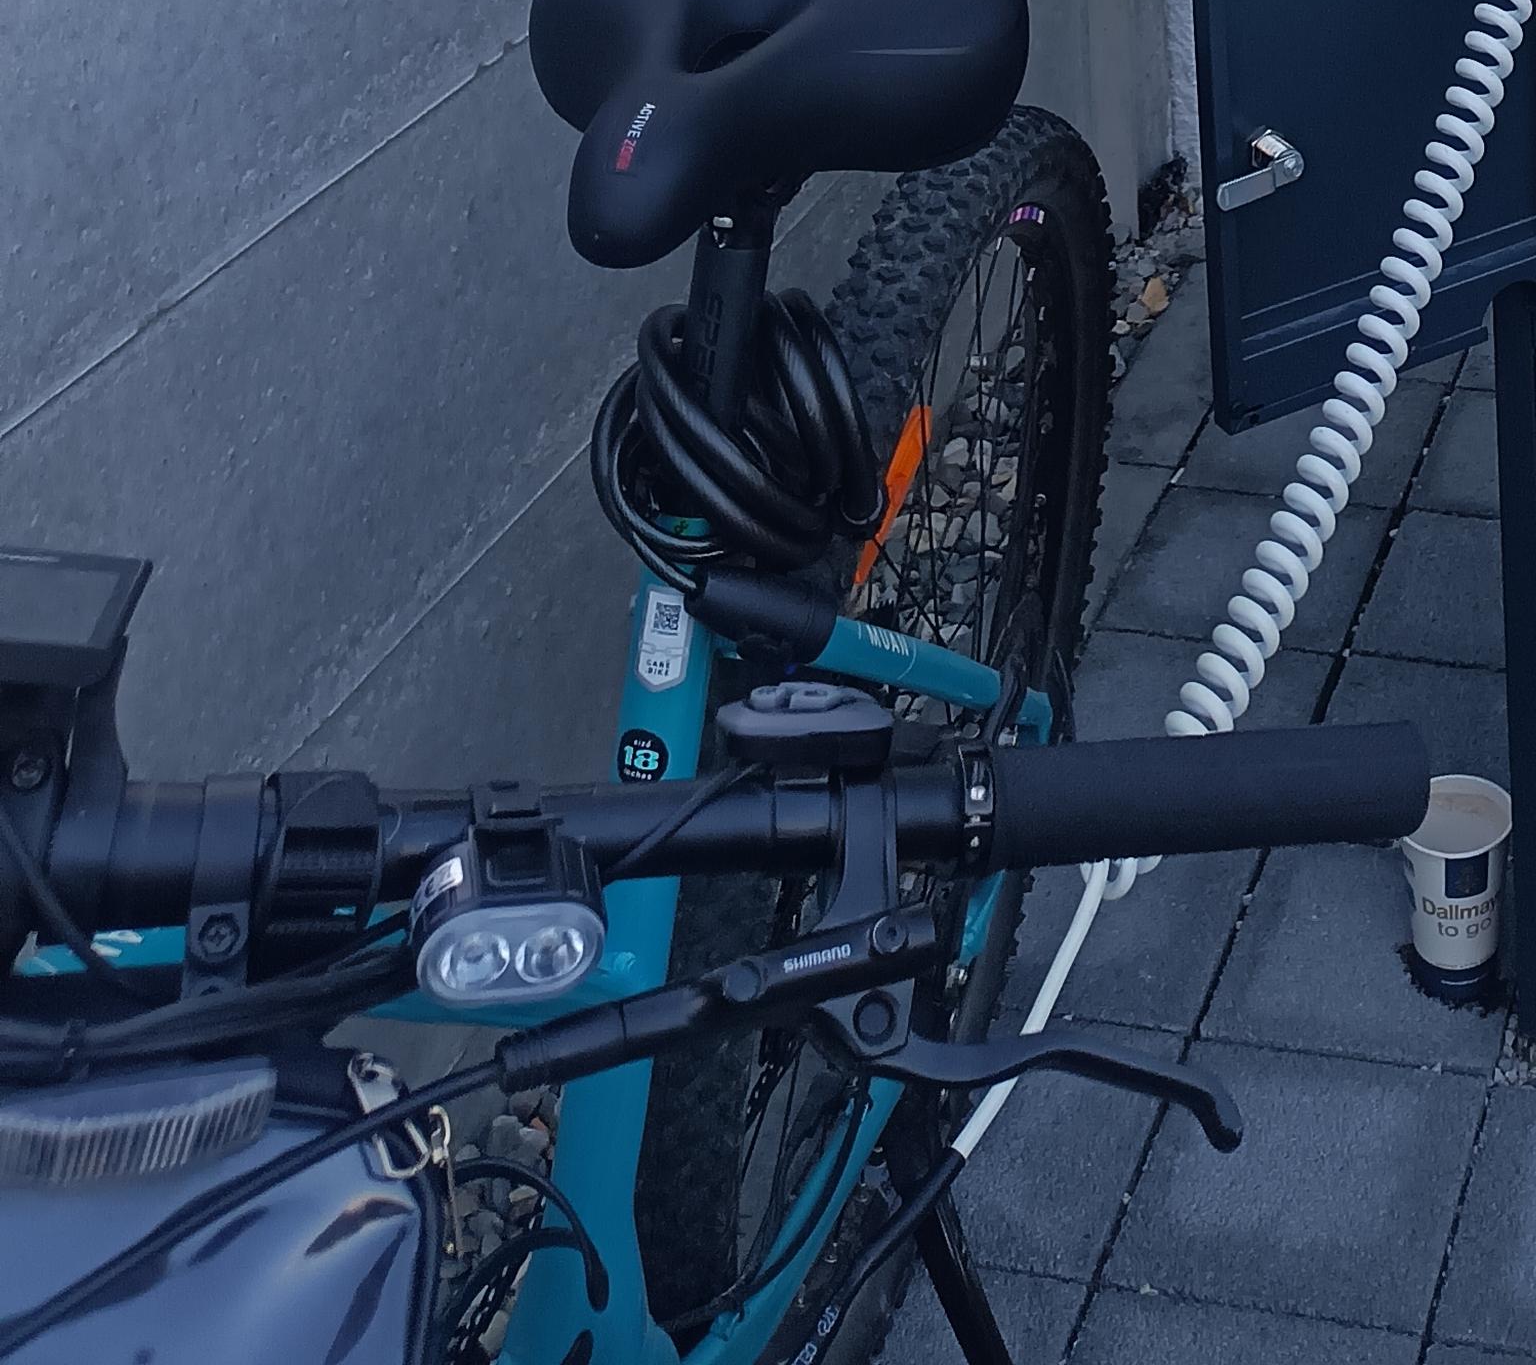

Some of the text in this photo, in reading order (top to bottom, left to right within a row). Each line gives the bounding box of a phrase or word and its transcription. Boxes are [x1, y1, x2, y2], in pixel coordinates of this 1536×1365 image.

[627, 102, 656, 139] ACTIVE
[623, 745, 660, 771] 18
[1422, 896, 1497, 920] Dallmay
[1437, 917, 1492, 939] to go
[783, 943, 851, 974] SHIMANO
